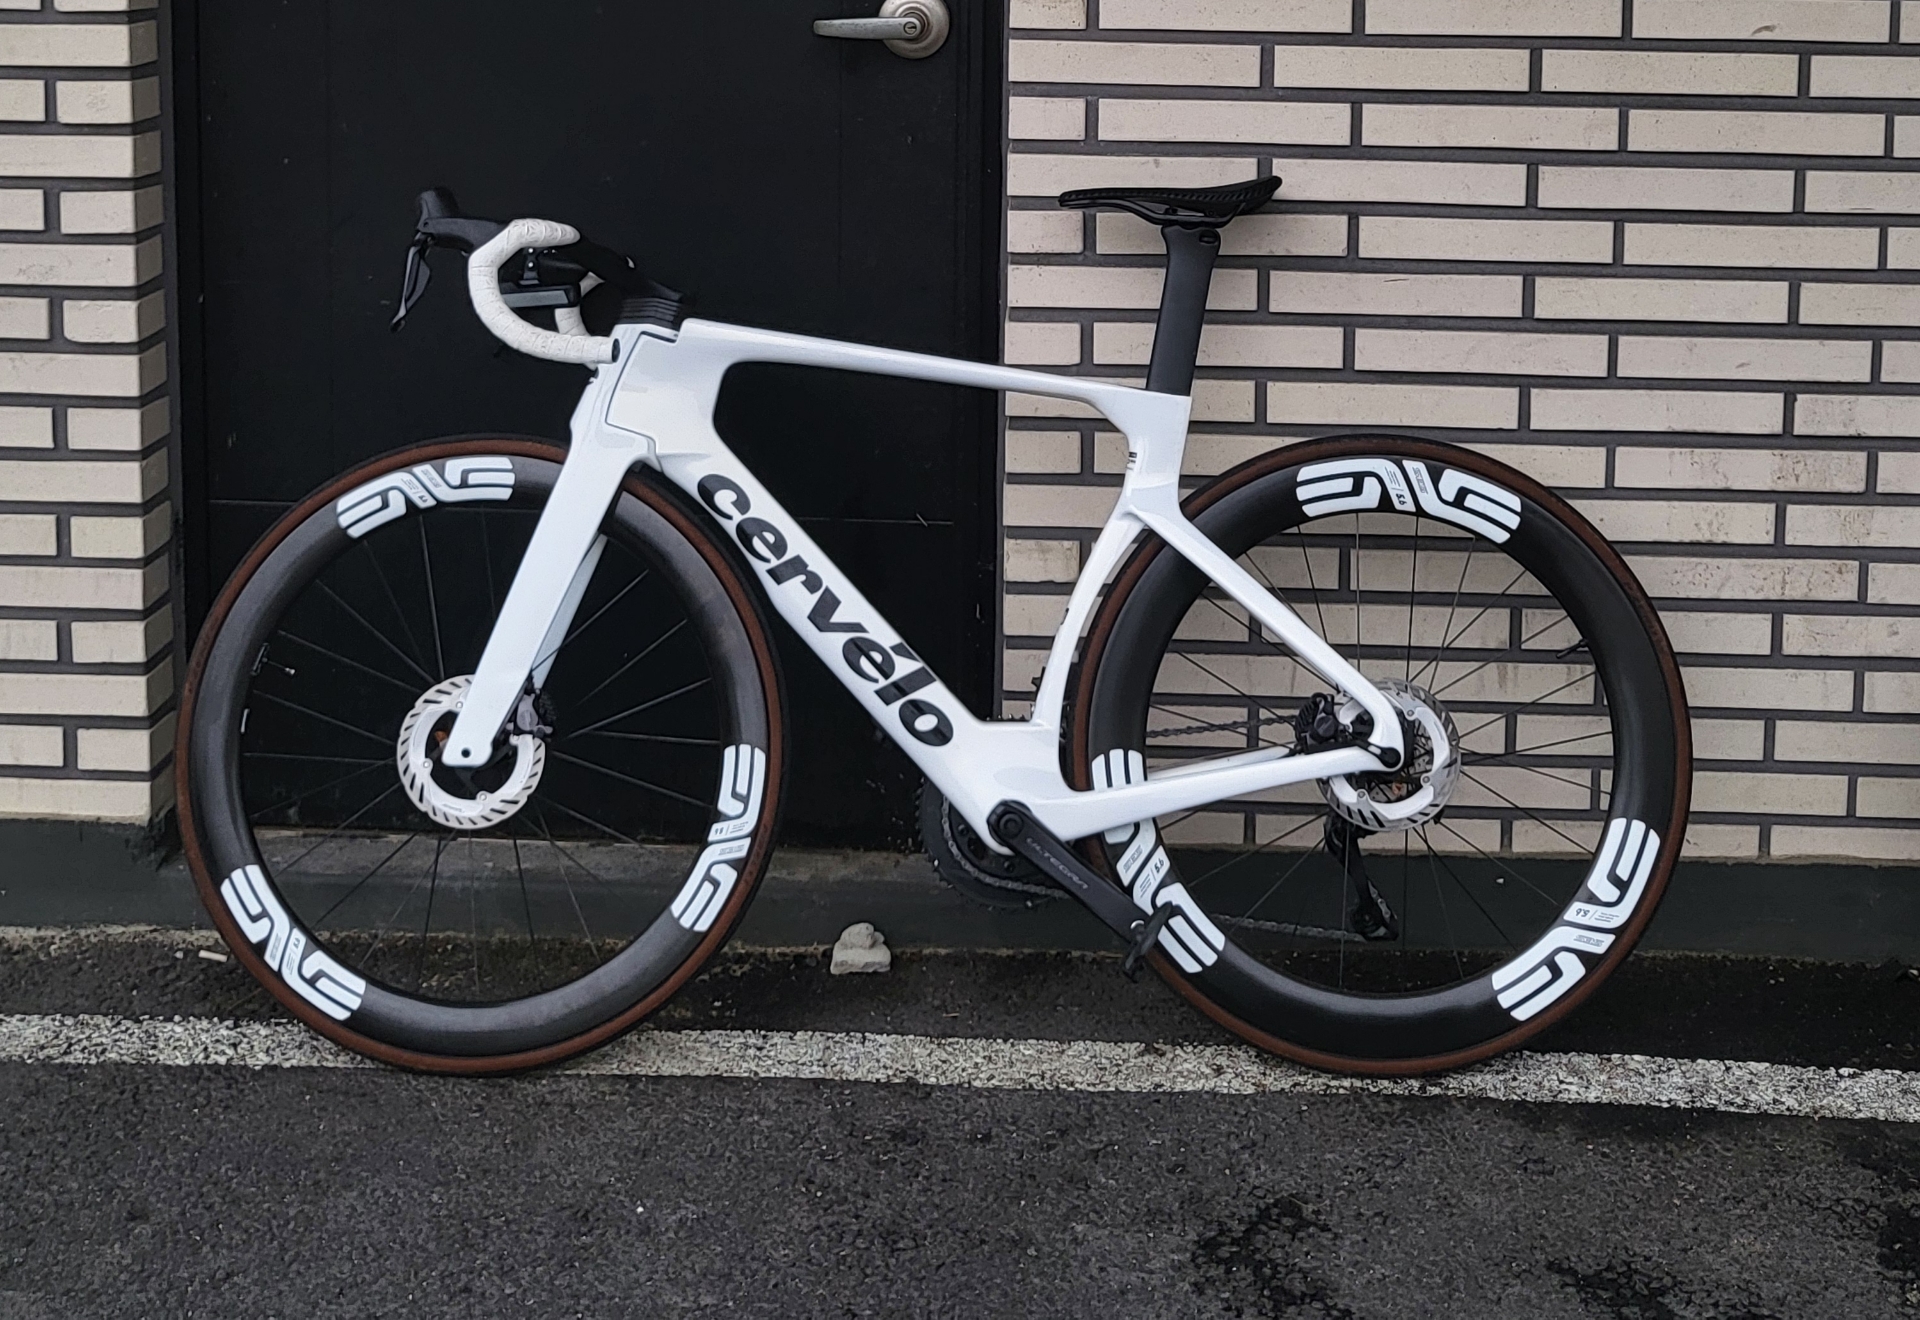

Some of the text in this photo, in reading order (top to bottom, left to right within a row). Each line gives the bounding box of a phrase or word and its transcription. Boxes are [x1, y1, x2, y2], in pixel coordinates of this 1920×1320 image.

[1396, 493, 1407, 506] 5.6
[697, 473, 954, 747] cervélo
[1025, 837, 1089, 890] ULTEGRA
[1154, 858, 1165, 872] 5.6
[1575, 907, 1590, 918] 5.6
